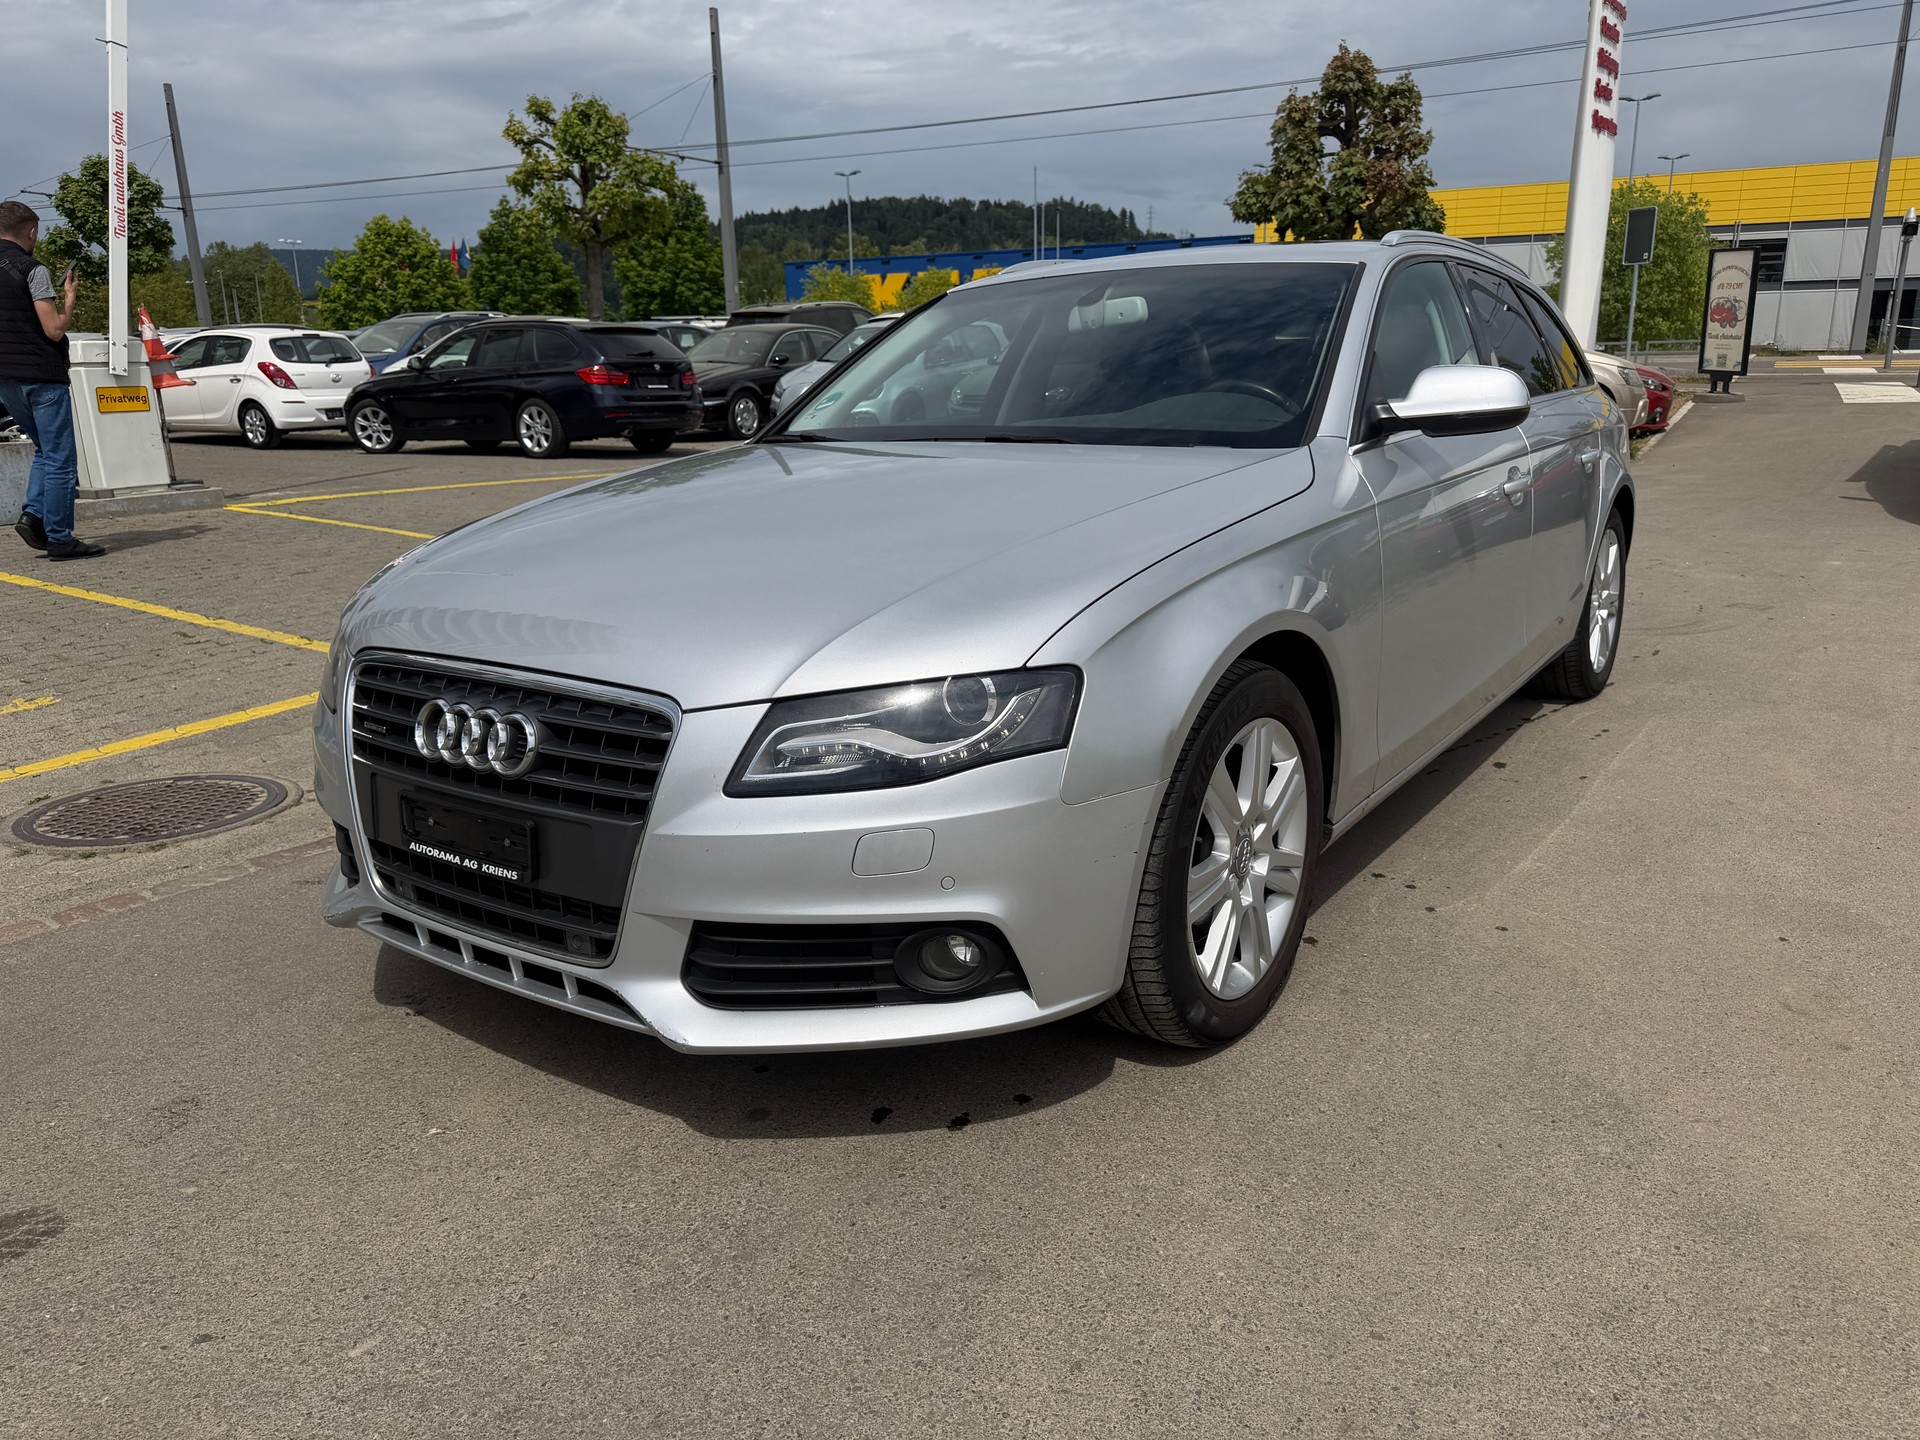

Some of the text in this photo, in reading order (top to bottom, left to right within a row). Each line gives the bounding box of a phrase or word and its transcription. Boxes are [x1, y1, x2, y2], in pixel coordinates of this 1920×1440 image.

[111, 110, 127, 239] Tivoli autohaus Gmbh
[98, 394, 148, 405] Privatweg
[409, 842, 518, 880] AUTORAMA AG KRIENS
